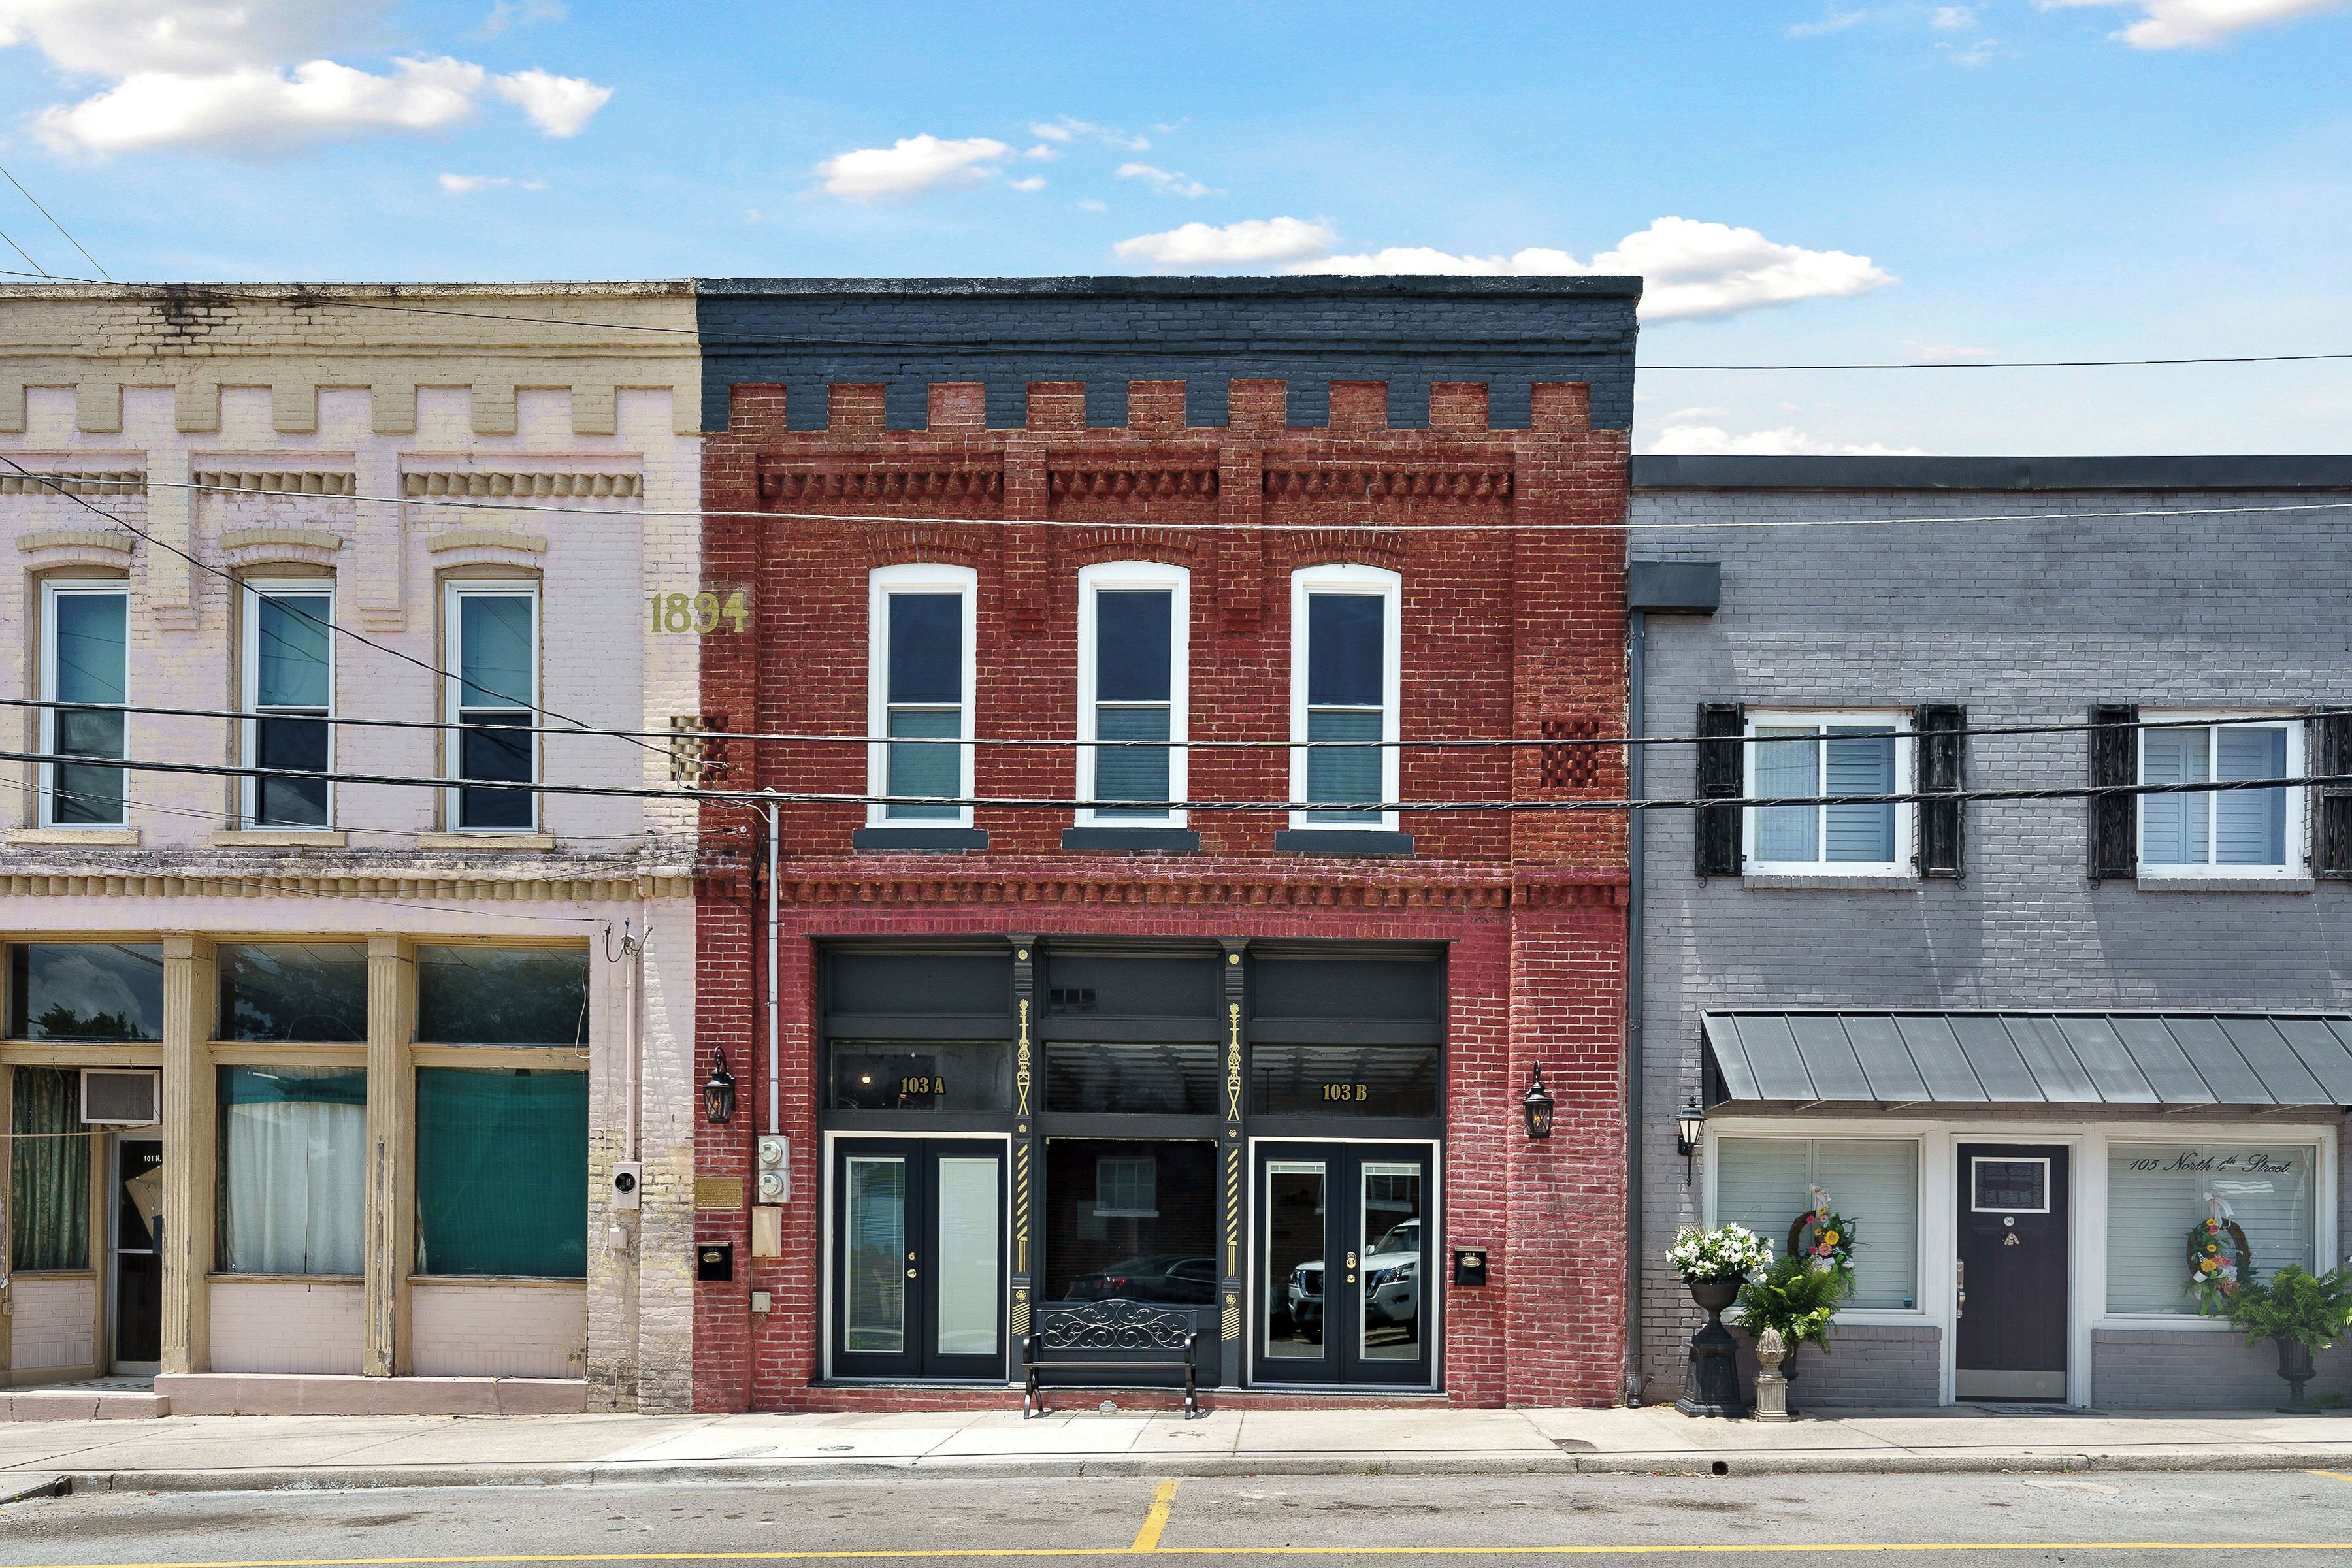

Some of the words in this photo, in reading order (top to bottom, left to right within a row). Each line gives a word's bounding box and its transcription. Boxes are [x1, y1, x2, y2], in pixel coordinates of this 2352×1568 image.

[651, 593, 749, 633] 1894
[900, 1077, 929, 1094] 103
[933, 1077, 945, 1094] A
[1322, 1083, 1350, 1100] 103
[1356, 1085, 1367, 1101] B
[2129, 1158, 2161, 1171] 105
[2163, 1152, 2215, 1171] North
[2216, 1154, 2239, 1172] 4th
[2241, 1154, 2292, 1173] Street
